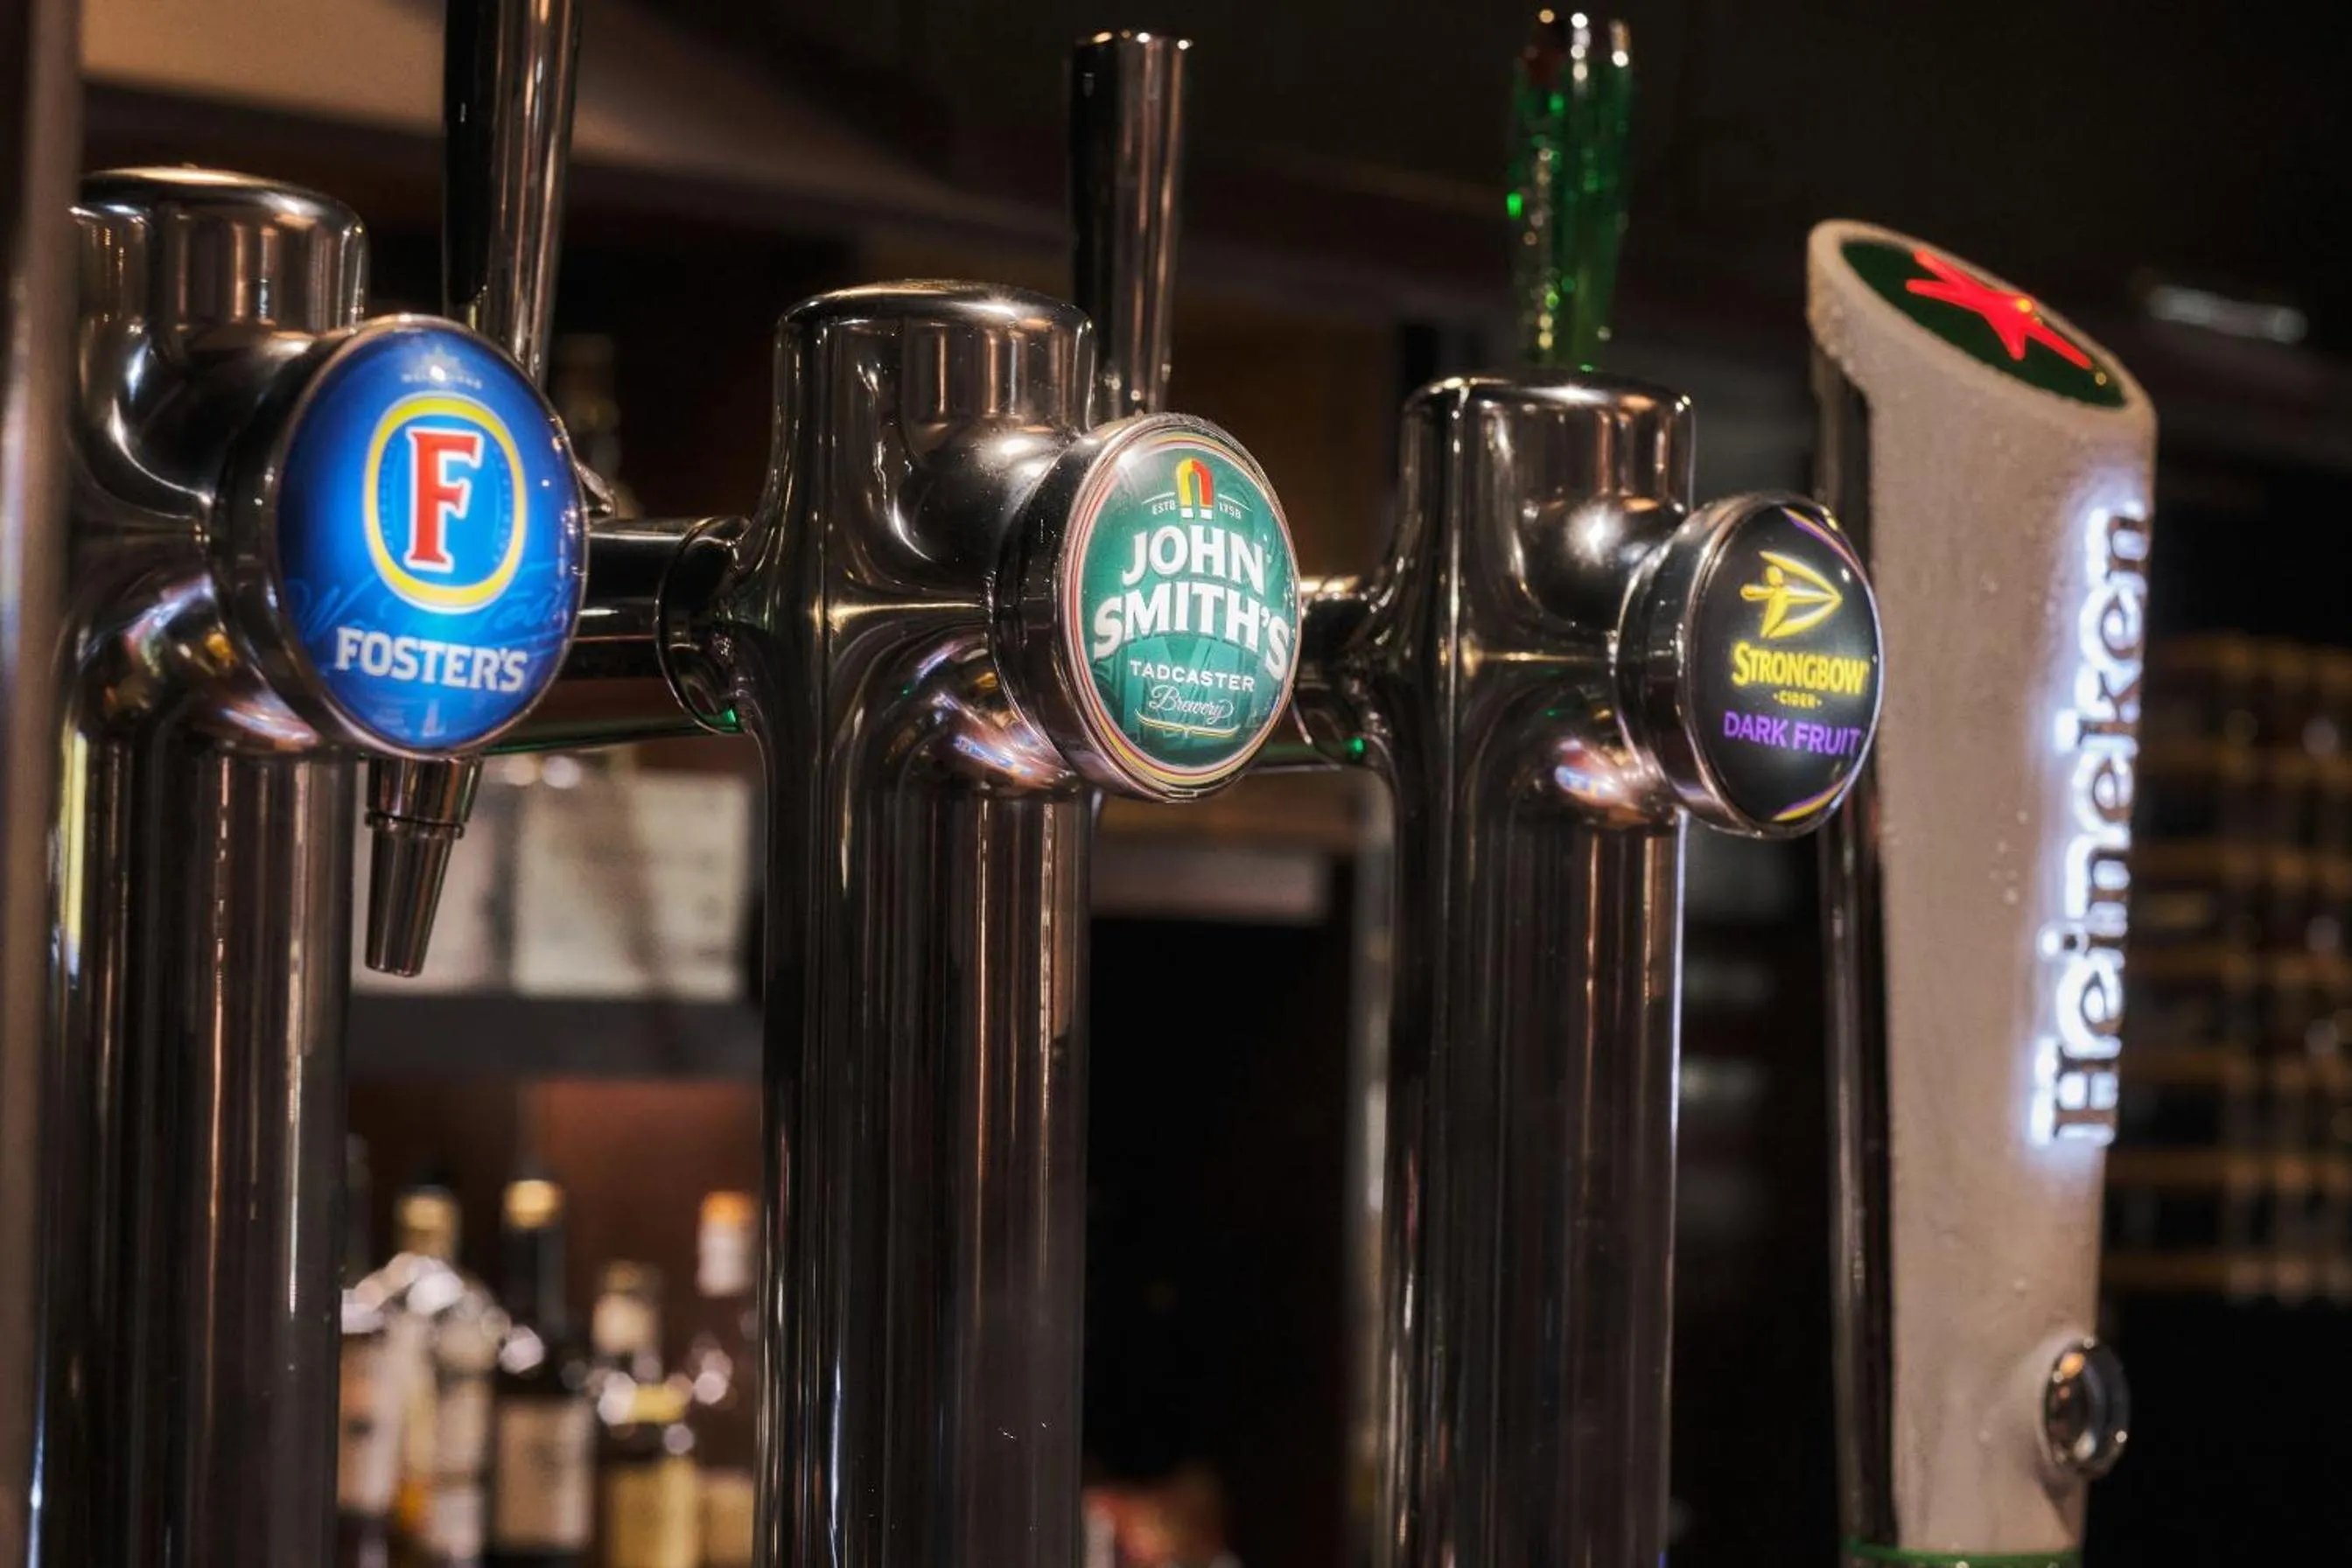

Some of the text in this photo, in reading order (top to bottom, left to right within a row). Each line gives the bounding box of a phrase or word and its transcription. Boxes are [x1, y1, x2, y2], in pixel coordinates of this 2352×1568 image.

[405, 427, 484, 573] F
[1122, 525, 1266, 595] JOHN
[335, 626, 528, 691] FOSTER'S
[1093, 581, 1289, 680] SMITH'S
[1130, 659, 1255, 692] TADCASTER
[1732, 640, 1868, 695] STRONGBOW
[1148, 684, 1234, 725] Brewery
[1724, 710, 1861, 756] DARK FRUIT
[2028, 500, 2149, 1145] Heineken
